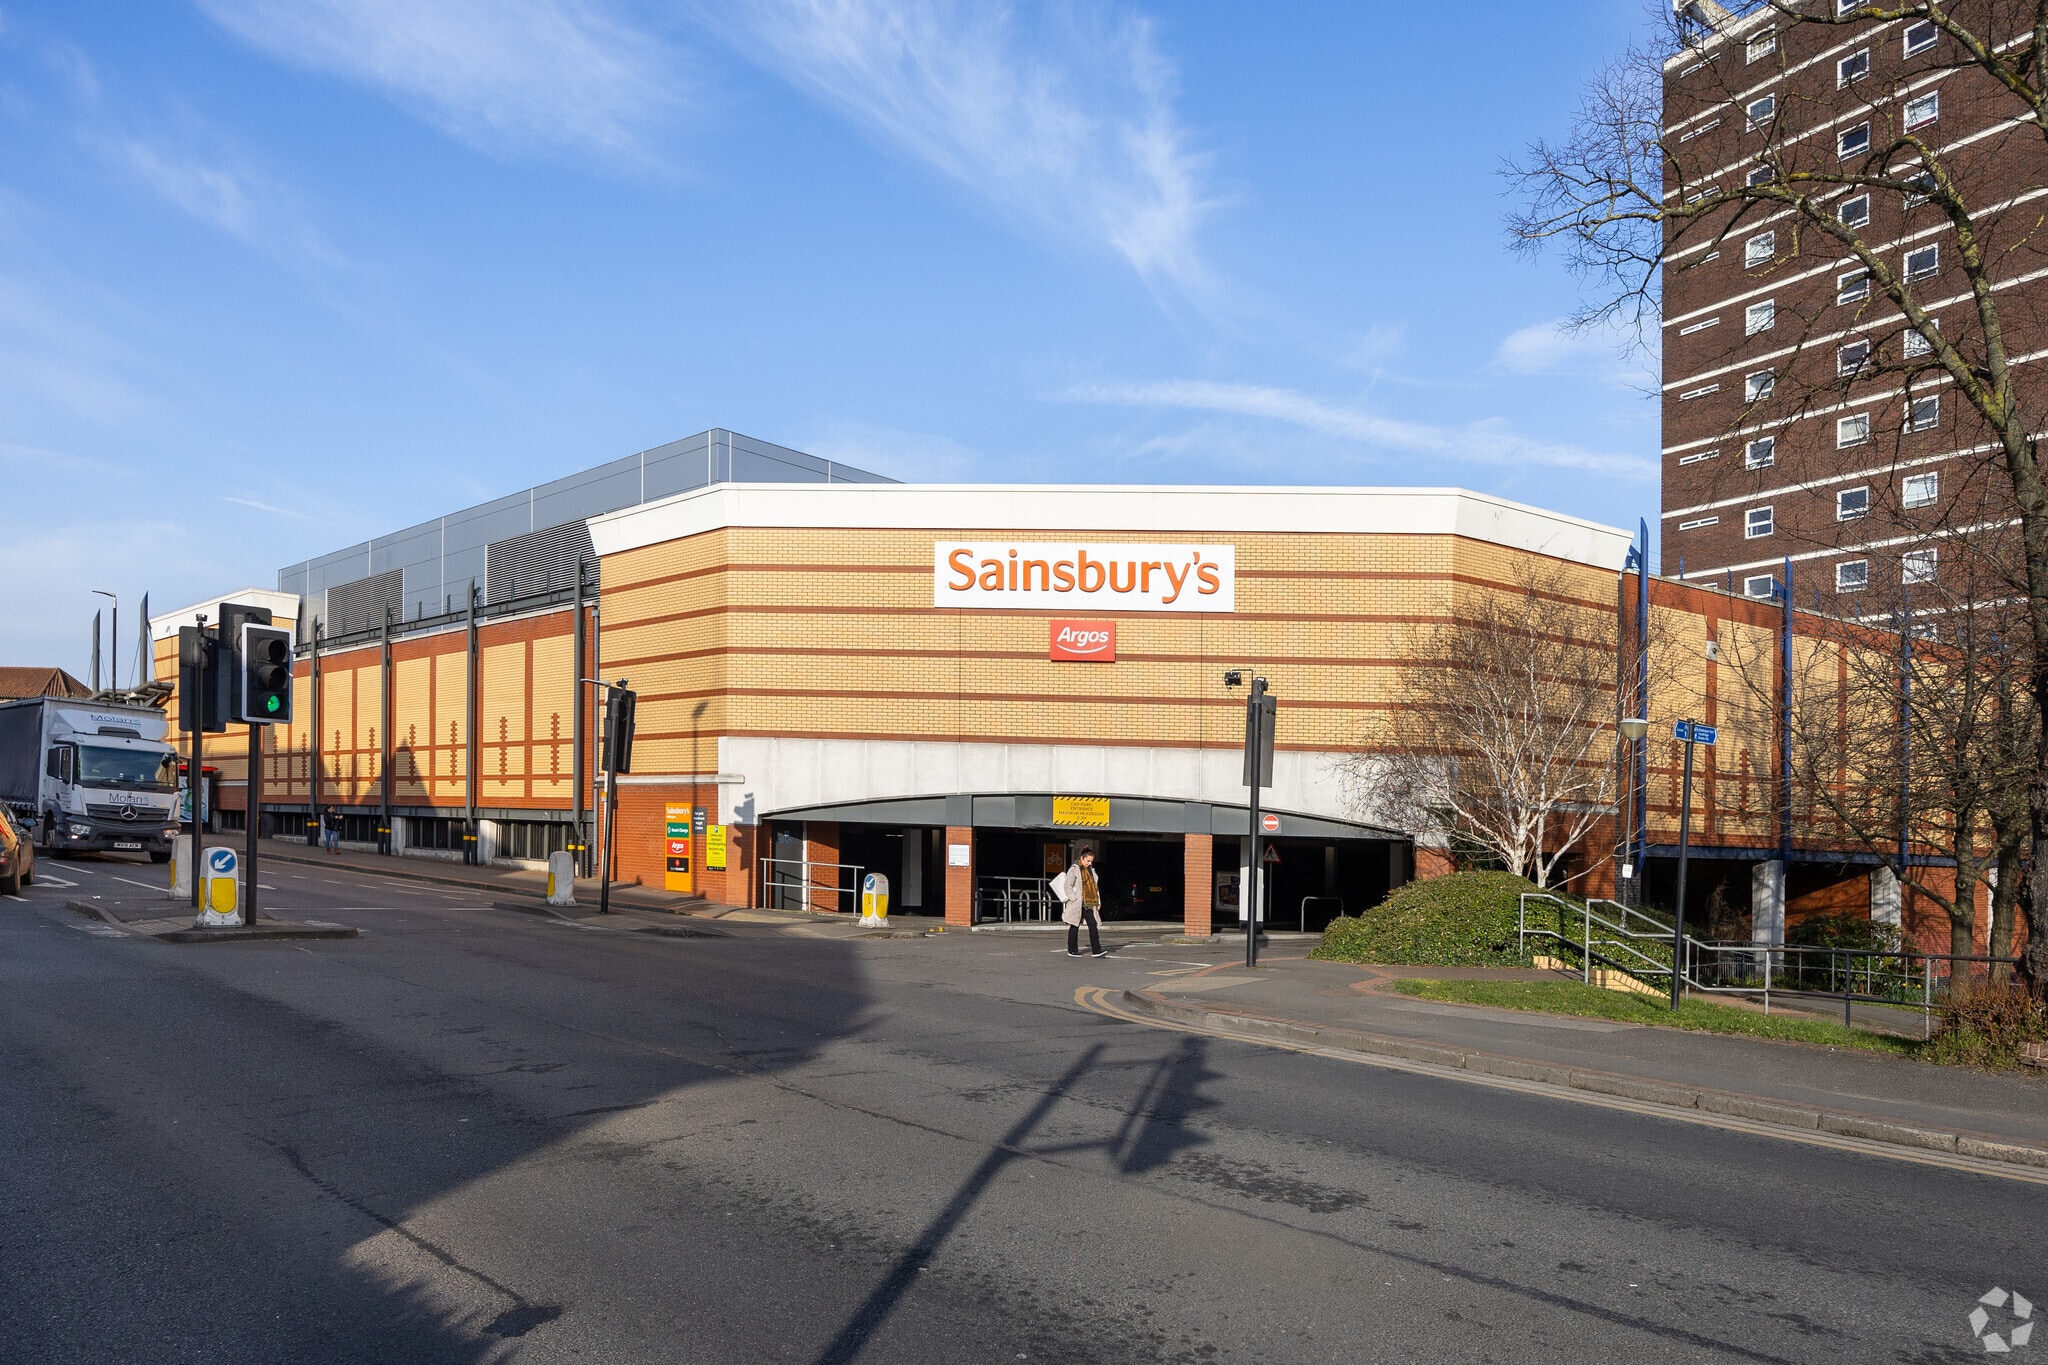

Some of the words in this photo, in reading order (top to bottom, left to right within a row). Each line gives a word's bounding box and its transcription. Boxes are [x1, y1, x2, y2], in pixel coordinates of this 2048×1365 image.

[948, 549, 1220, 604] Sainsbury's
[1056, 626, 1109, 647] Argos
[666, 807, 689, 815] Sainsbury's
[671, 841, 684, 850] Argos
